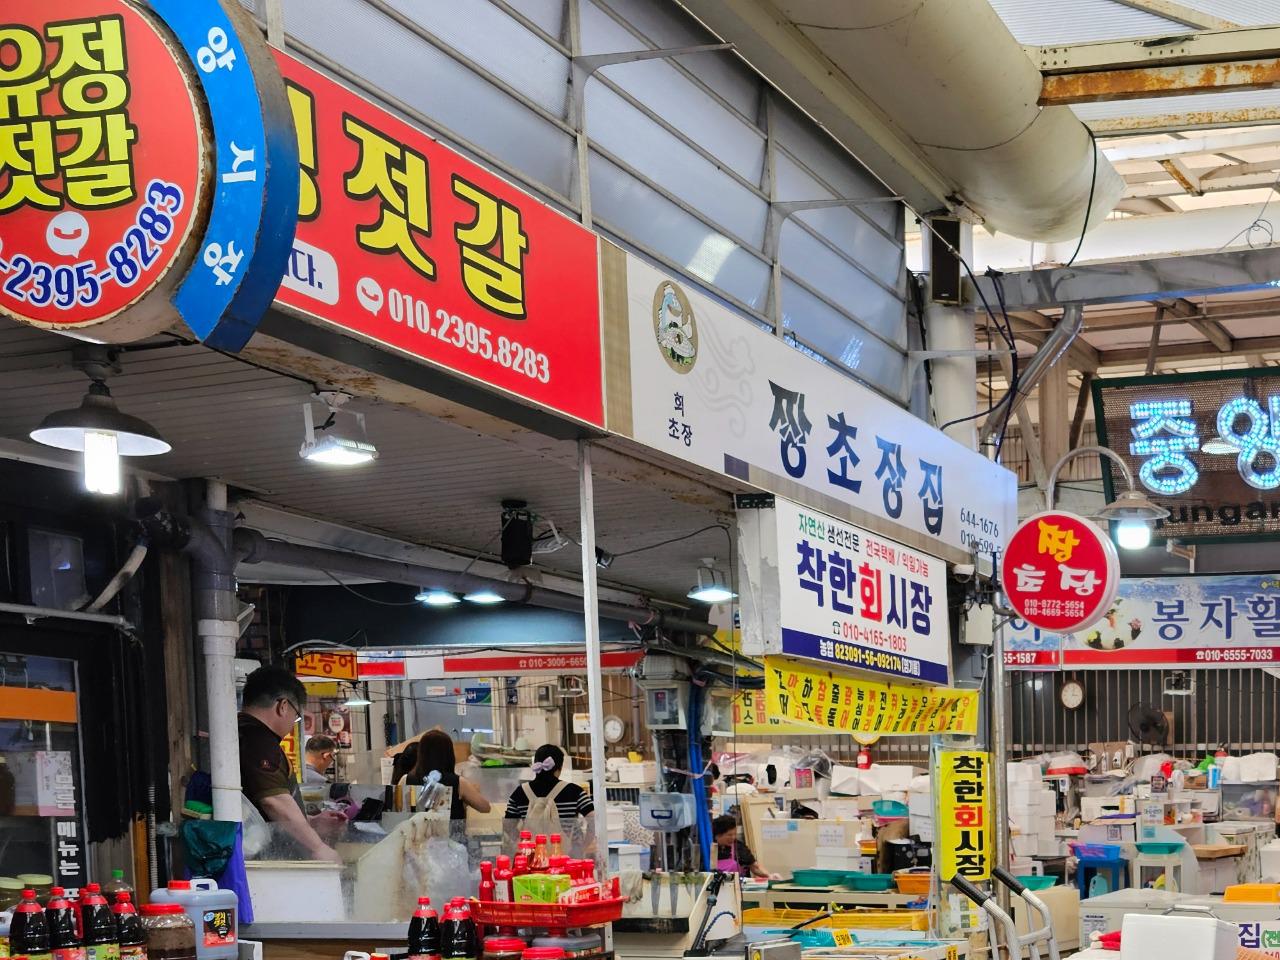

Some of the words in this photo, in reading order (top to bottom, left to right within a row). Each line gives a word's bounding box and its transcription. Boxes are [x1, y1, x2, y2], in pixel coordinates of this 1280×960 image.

[387, 287, 552, 385] 010.2395.8283
[673, 391, 685, 418] 회
[668, 417, 693, 447] 초장
[767, 378, 946, 537] 짱초장집
[960, 507, 999, 538] 644-1676
[798, 513, 825, 540] 자연산
[827, 525, 860, 553] 생선전문
[865, 538, 896, 566] 전국택배
[1037, 519, 1080, 563] 짱
[796, 538, 933, 636] 착한회시장
[1012, 563, 1102, 596] 초장
[1024, 598, 1085, 610] 010-8772-5654
[842, 622, 907, 653] 010-4165-1803
[1205, 649, 1273, 661] 010-6555-7033
[953, 755, 986, 876] 착한회시장
